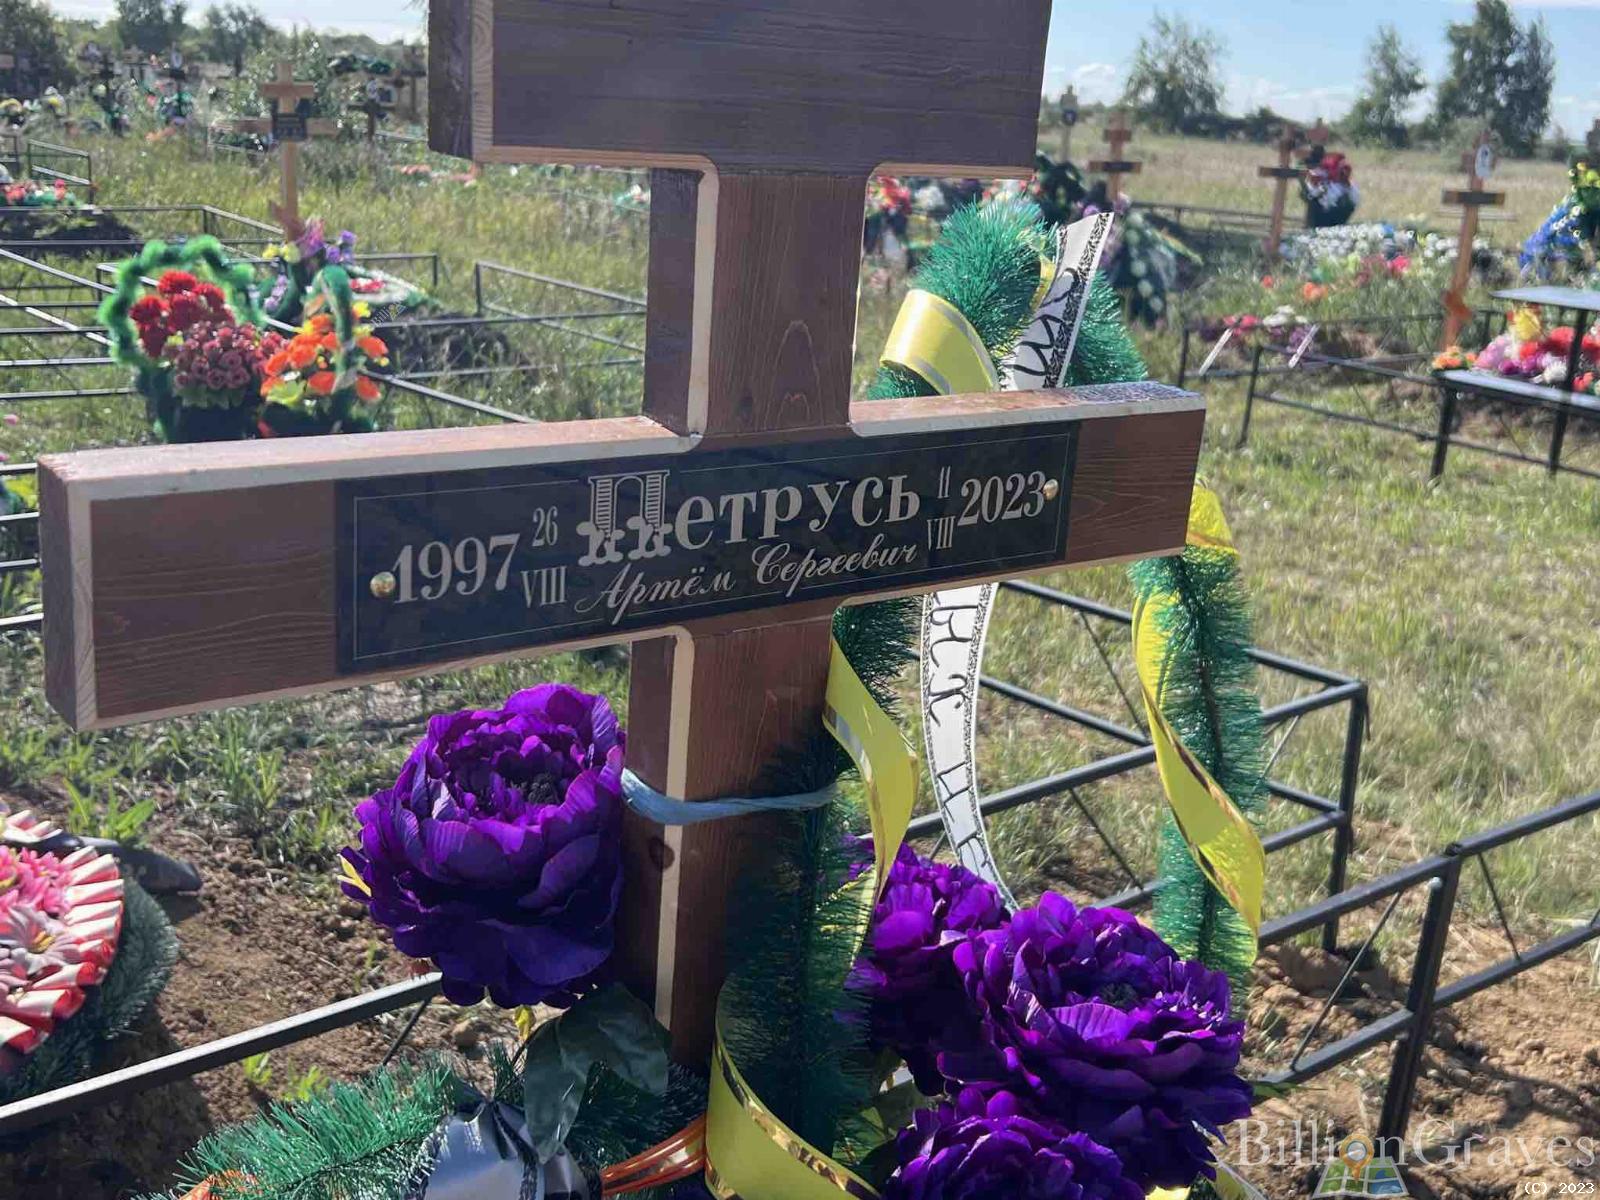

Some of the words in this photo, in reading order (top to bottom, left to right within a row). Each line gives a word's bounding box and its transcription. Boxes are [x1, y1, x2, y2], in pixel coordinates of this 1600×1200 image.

[576, 469, 920, 566] Петрусь
[957, 470, 1046, 526] 2023
[532, 506, 559, 547] 26
[927, 515, 956, 551] VIII
[393, 533, 521, 604] 1997
[522, 566, 567, 608] VIII
[574, 563, 736, 626] Артём
[752, 533, 917, 598] Сергеевич
